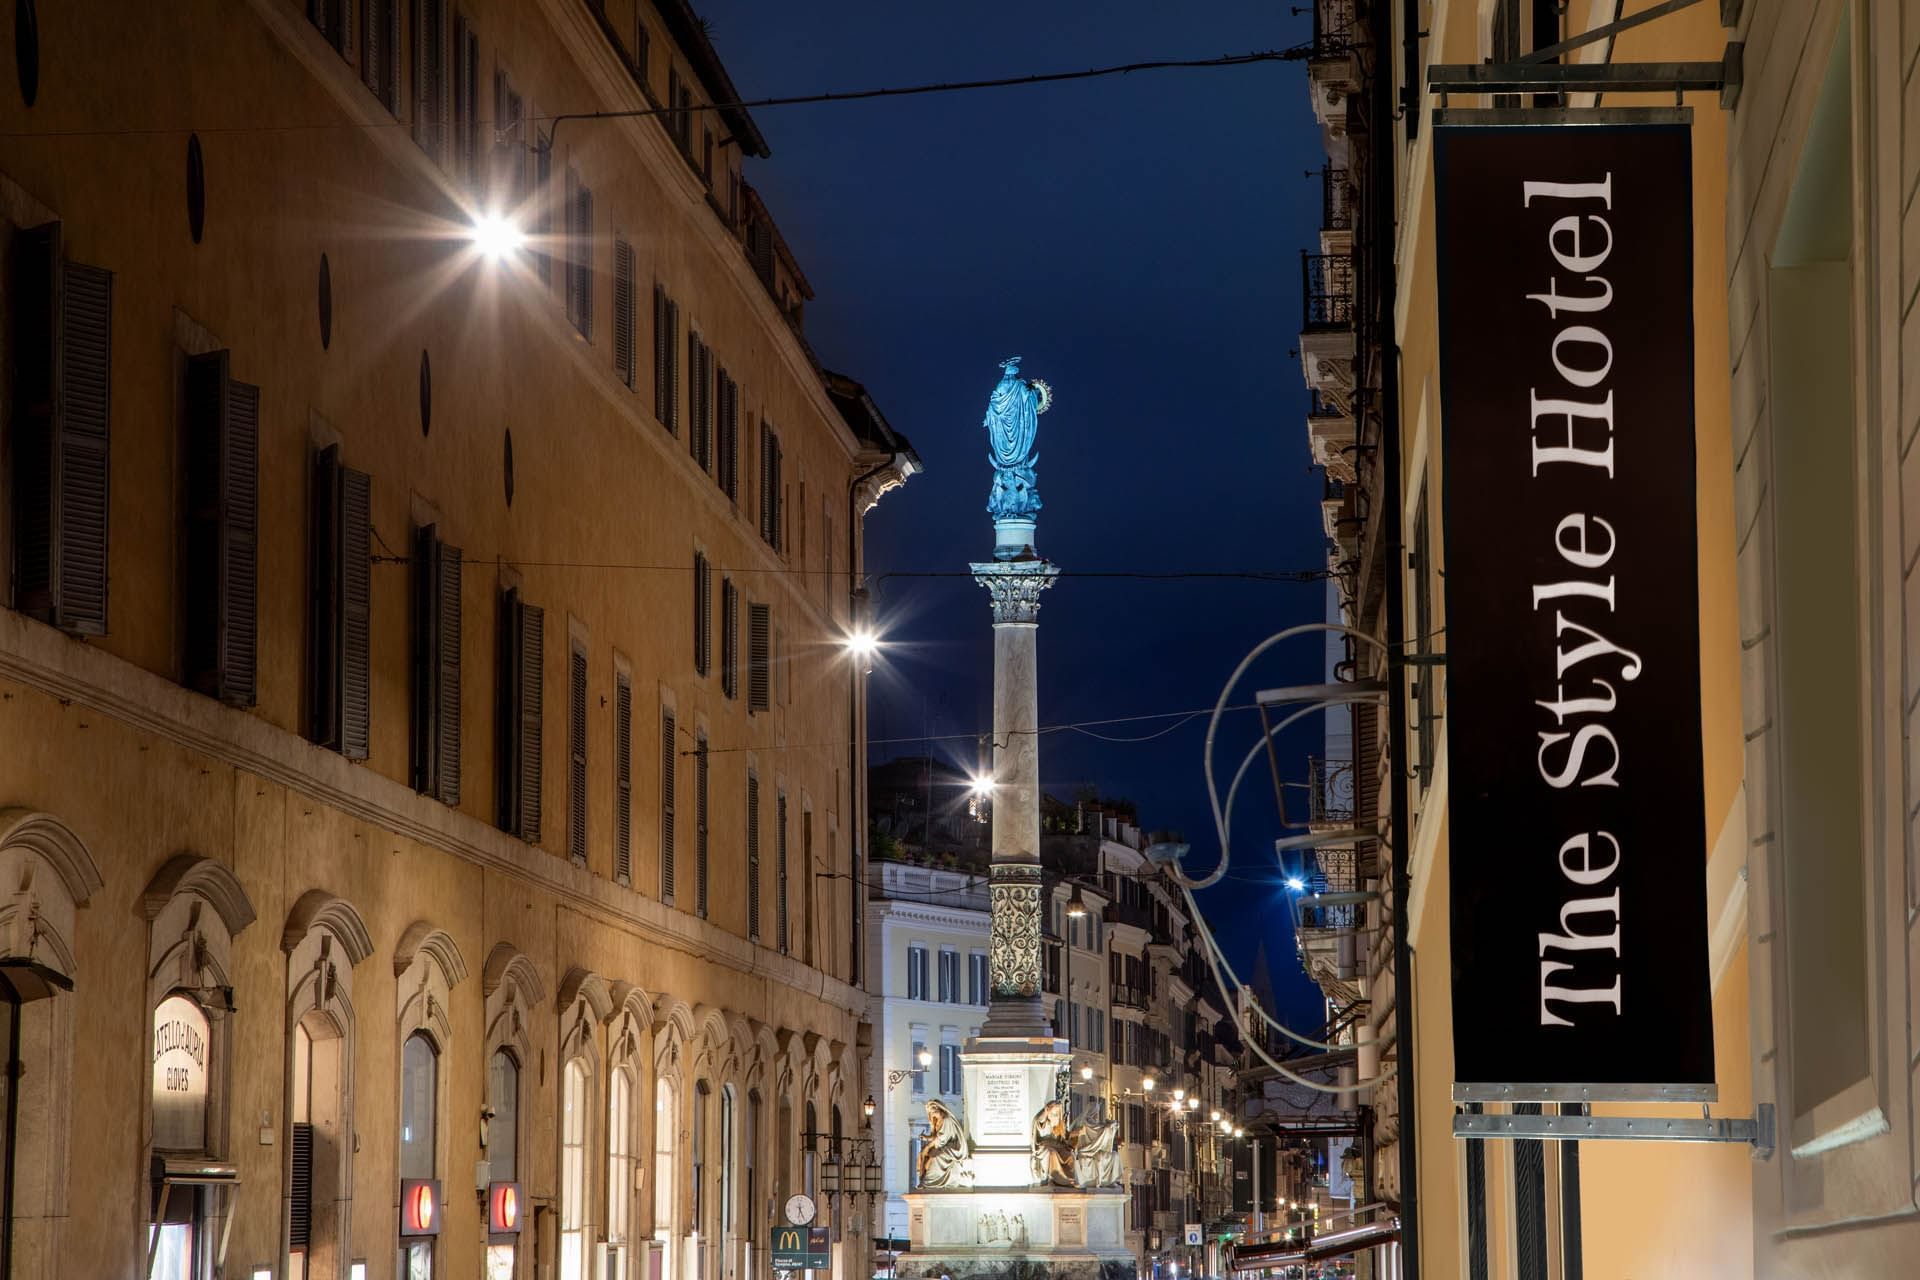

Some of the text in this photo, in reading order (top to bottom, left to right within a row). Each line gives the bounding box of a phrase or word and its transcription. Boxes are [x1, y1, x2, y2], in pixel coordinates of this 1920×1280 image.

[1524, 172, 1642, 1027] The Style Hotel
[153, 1020, 180, 1065] ATELLO
[167, 1067, 188, 1091] GLOVES
